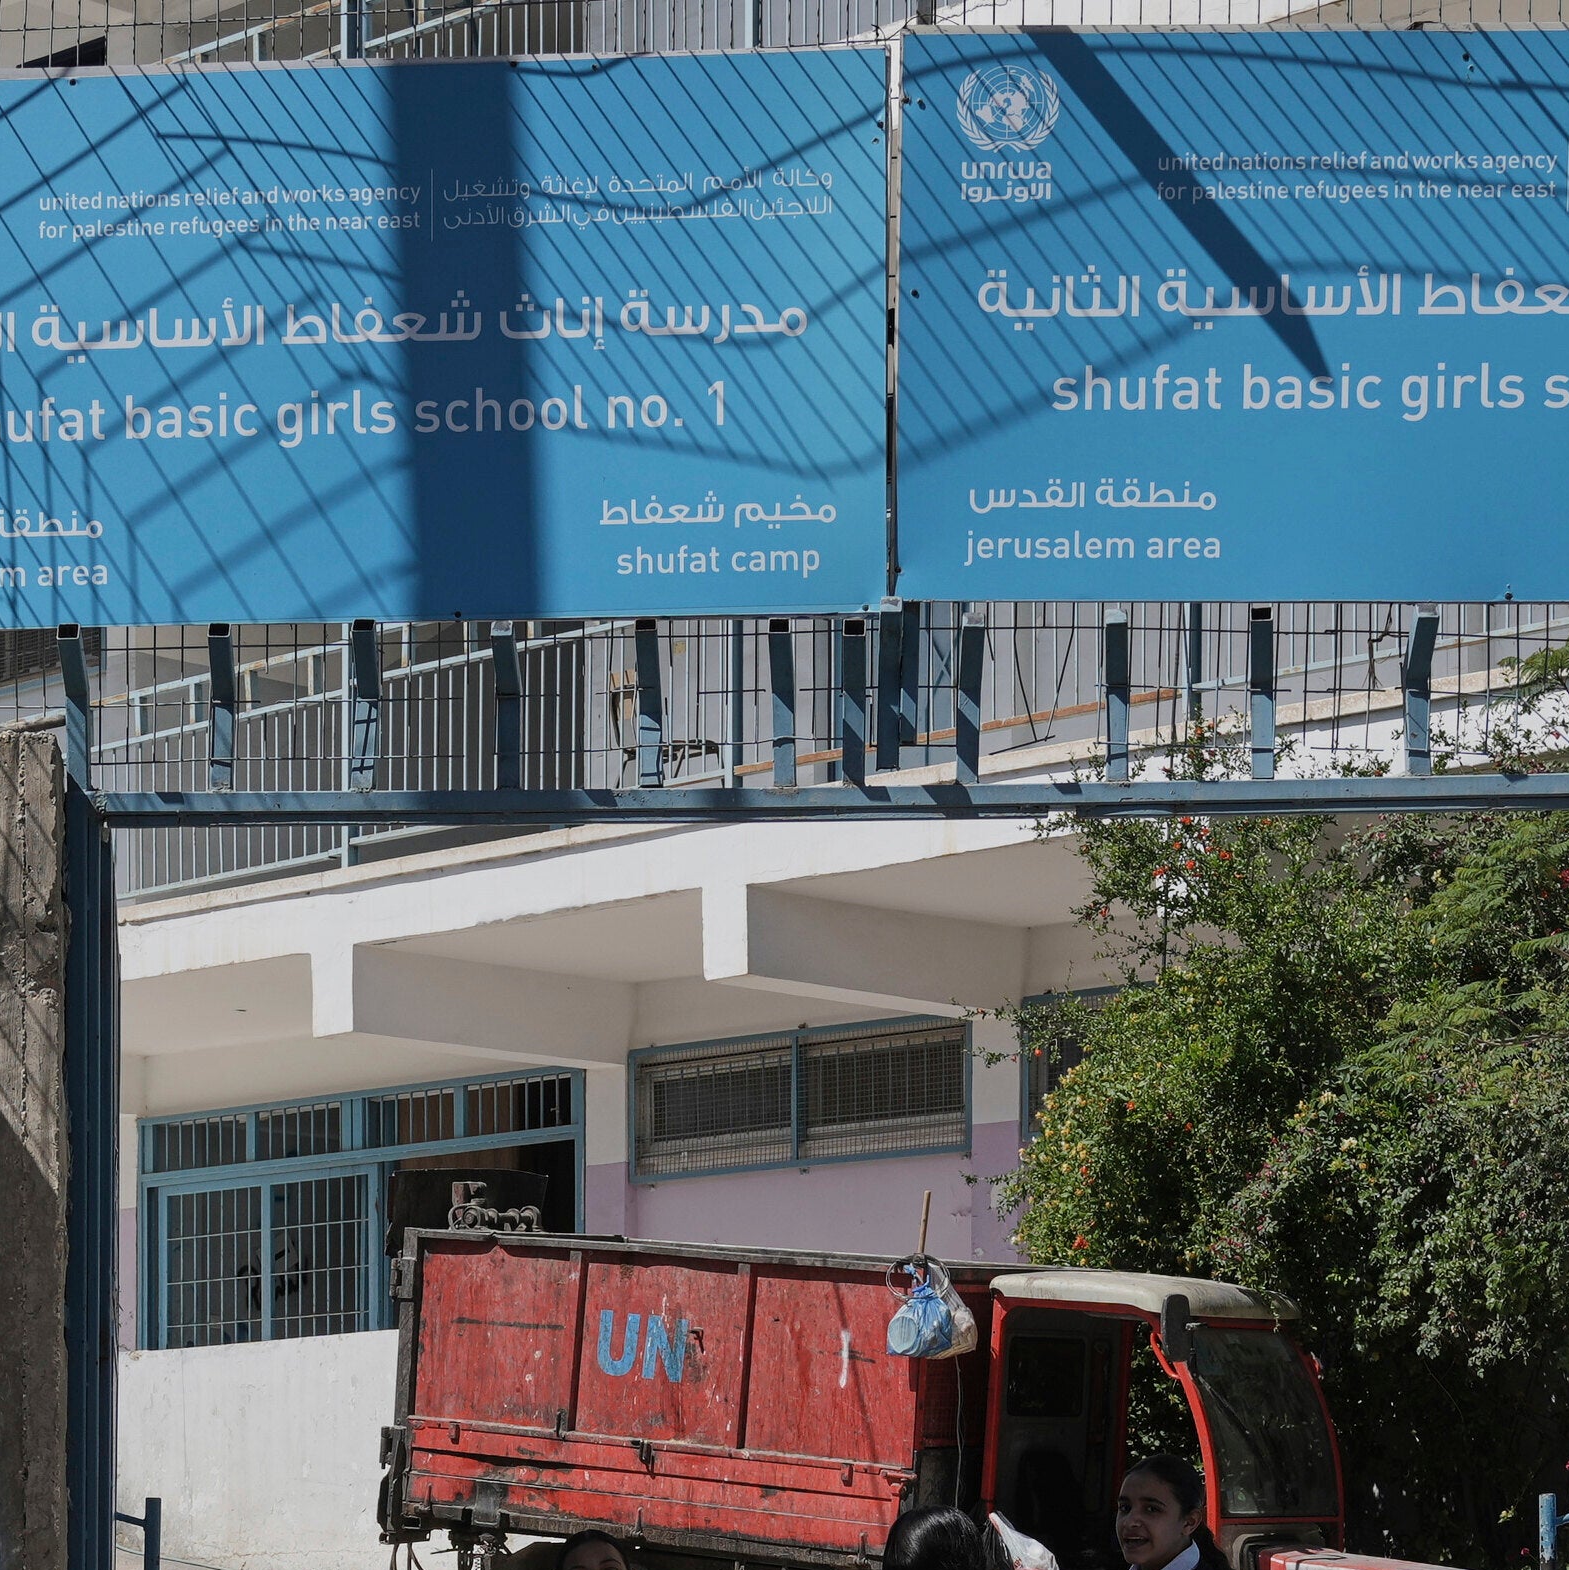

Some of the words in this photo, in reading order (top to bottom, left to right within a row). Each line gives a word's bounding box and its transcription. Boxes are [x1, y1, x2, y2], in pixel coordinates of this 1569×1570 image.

[772, 167, 834, 190] وكالة
[961, 161, 1052, 180] unrwa
[1158, 151, 1225, 171] united
[1228, 151, 1307, 171] nations
[1310, 150, 1368, 170] relief
[1370, 150, 1409, 170] and
[1412, 150, 1479, 170] works
[1481, 154, 1558, 175] agency
[39, 191, 103, 212] united
[106, 189, 182, 209] nations
[184, 186, 239, 207] relief
[241, 185, 279, 205] and
[281, 184, 346, 204] works
[348, 186, 421, 207] agency
[443, 176, 531, 202] وتشغيل
[608, 172, 693, 194] المتحدة
[1156, 181, 1188, 201] for
[1192, 180, 1289, 204] palestine
[1294, 179, 1389, 204] refugees
[1394, 183, 1413, 199] in
[1417, 179, 1452, 199] the
[1457, 183, 1507, 199] near
[1511, 180, 1557, 199] east
[507, 202, 571, 229] الشرق
[572, 207, 610, 230] في
[611, 198, 749, 226] الفلسطينيين
[749, 195, 834, 221] اللاجئين
[38, 220, 69, 239] for
[72, 219, 165, 243] palestine
[170, 215, 260, 239] refugees
[265, 213, 284, 233] in
[287, 213, 321, 232] the
[325, 215, 373, 231] near
[377, 211, 421, 230] east
[977, 264, 1141, 331] الثانية
[1156, 264, 1402, 330] الأساسية
[31, 297, 265, 364] الأساسية
[281, 290, 482, 345] شعفاط
[499, 293, 606, 351] إناث
[620, 289, 808, 344] مدرسة
[1052, 363, 1222, 411] shufat
[1242, 362, 1382, 410] basic
[1401, 362, 1525, 422] girls
[125, 392, 258, 440] basic
[277, 389, 396, 449] girls
[414, 384, 589, 433] school
[607, 394, 684, 429] no.
[707, 380, 725, 426] 1
[599, 490, 725, 526] شعفاط
[734, 494, 837, 529] مخيم
[969, 478, 1086, 514] القدس
[1095, 478, 1217, 511] منطقة
[617, 544, 720, 575] shufat
[731, 549, 821, 579] camp
[963, 530, 1135, 567] jerusalem
[1146, 537, 1221, 559] area
[37, 564, 108, 587] area
[596, 1309, 689, 1383] UN
